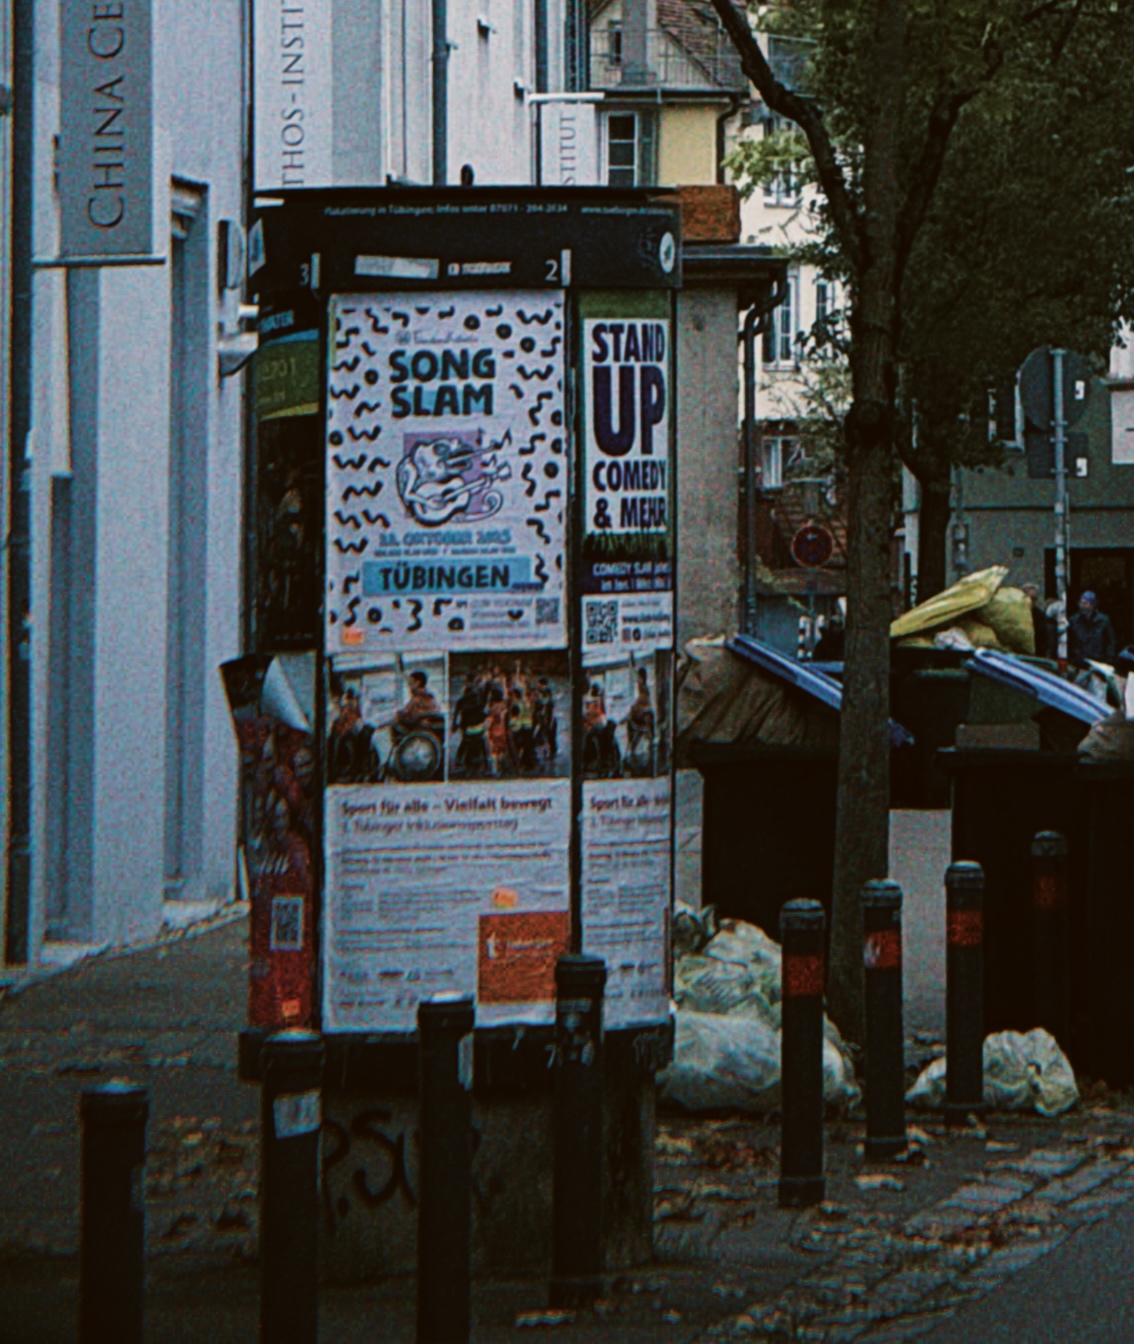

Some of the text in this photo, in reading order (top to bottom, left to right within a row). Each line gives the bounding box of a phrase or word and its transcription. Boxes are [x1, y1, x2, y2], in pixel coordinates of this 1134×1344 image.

[87, 75, 124, 229] CHINA
[545, 258, 559, 281] 2
[591, 322, 666, 363] STAND
[388, 347, 496, 384] SONG
[390, 382, 494, 419] SLAM
[592, 365, 666, 457] UP
[592, 460, 667, 492] COMEDY
[593, 496, 667, 529] & MEHR
[379, 561, 510, 591] TÜBINGEN
